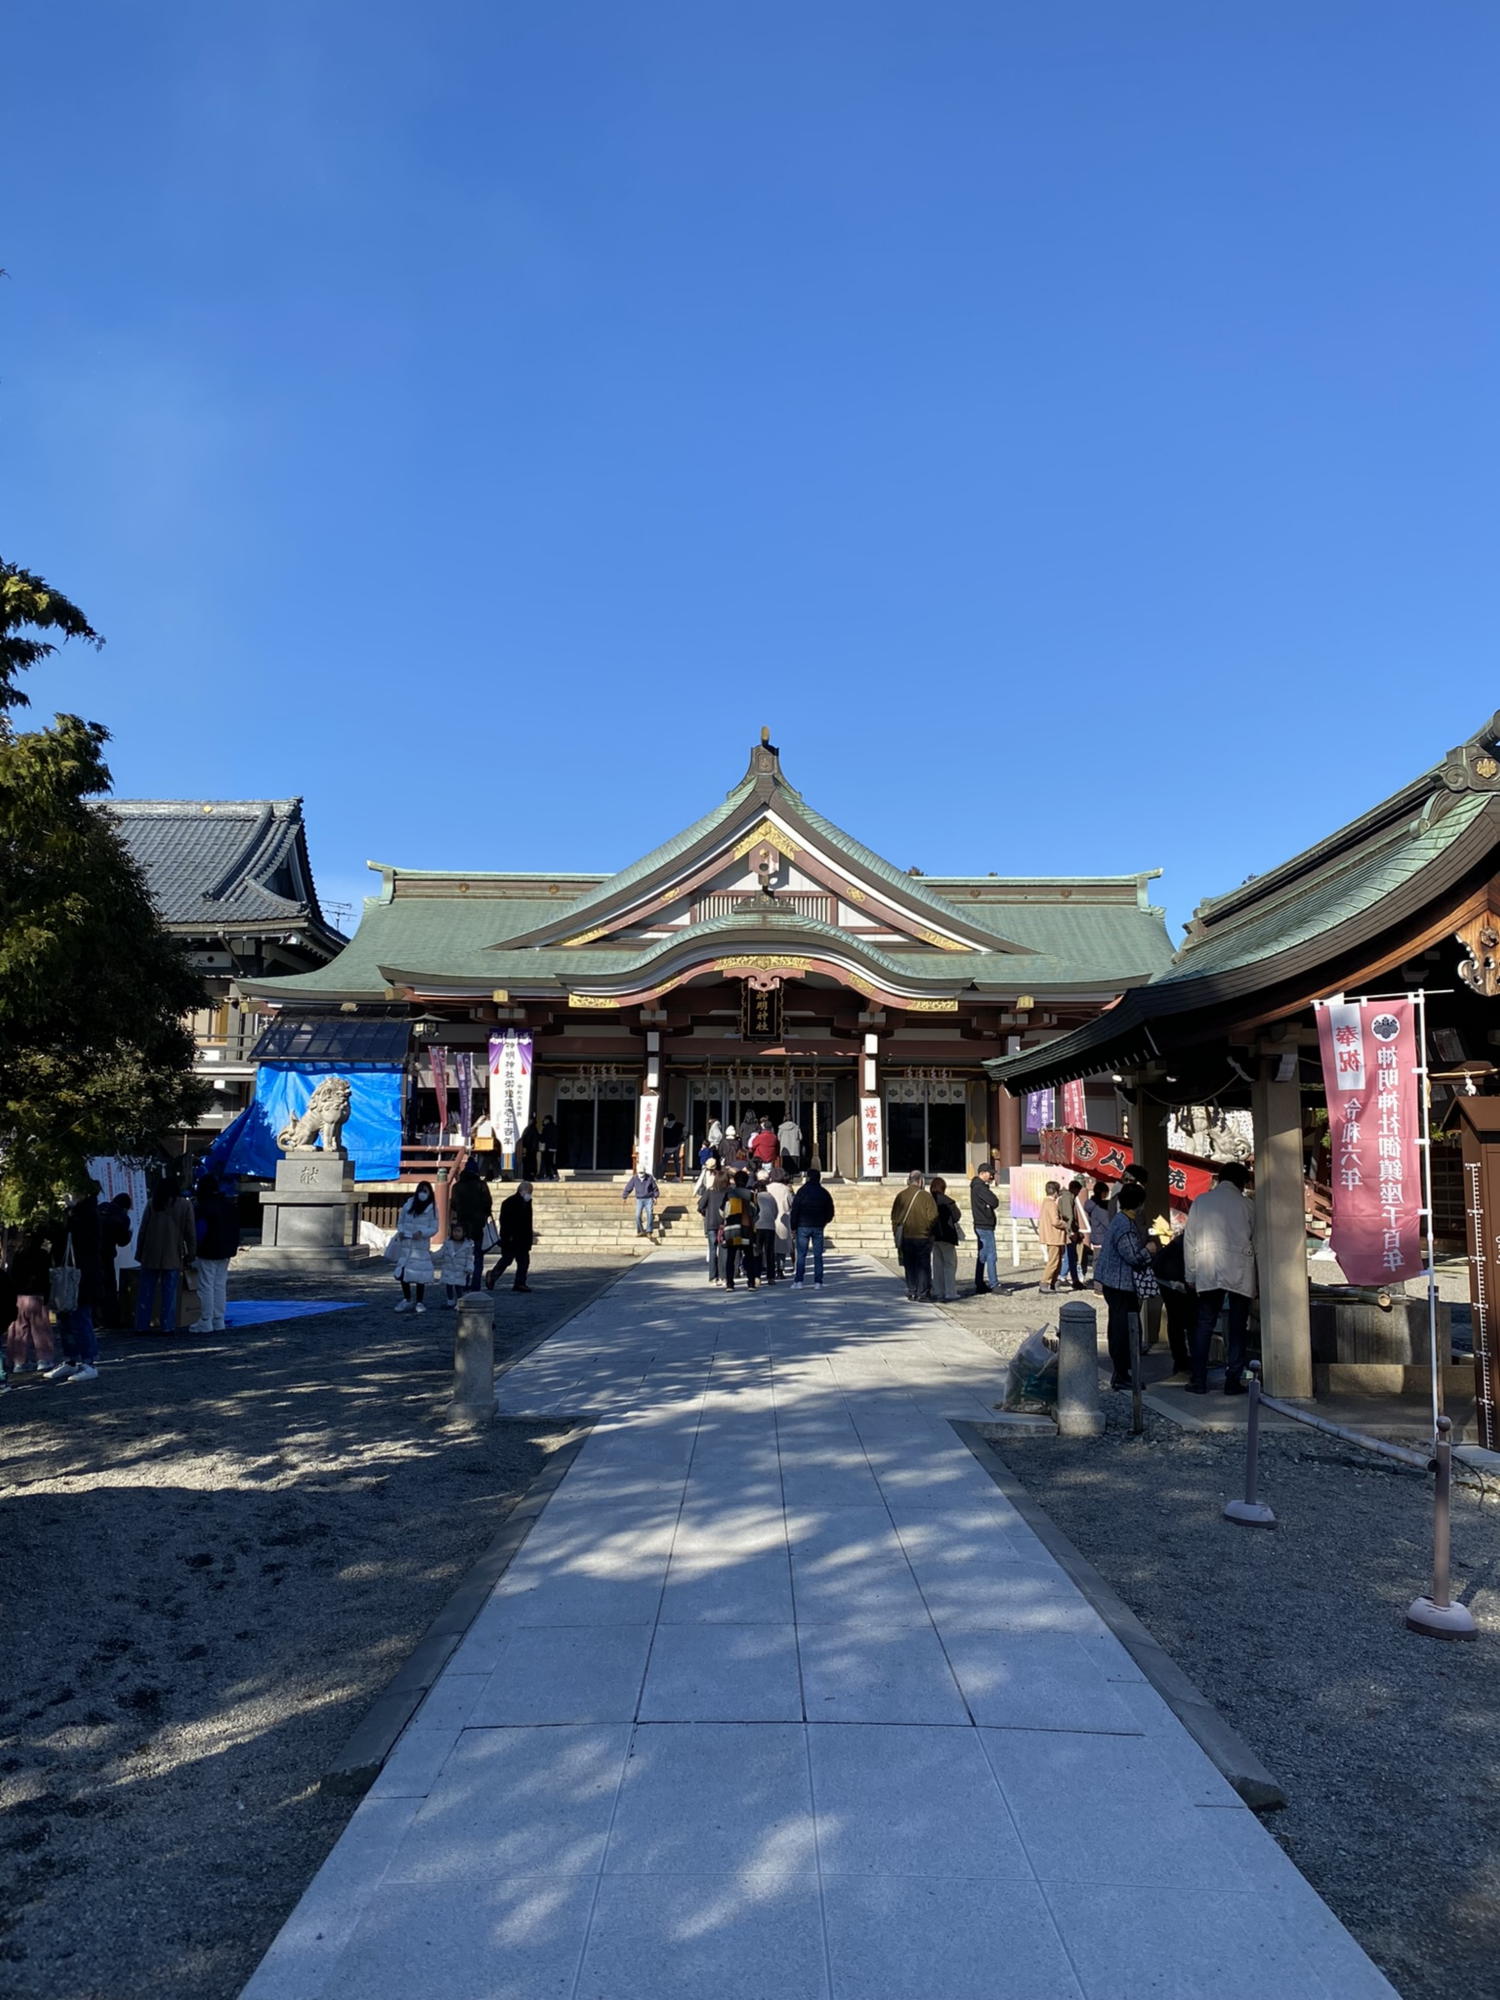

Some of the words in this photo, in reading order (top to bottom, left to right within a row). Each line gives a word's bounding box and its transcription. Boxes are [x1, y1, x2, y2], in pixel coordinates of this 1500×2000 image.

[756, 991, 769, 1031] 神明神社
[865, 1106, 880, 1169] 謹賀新年
